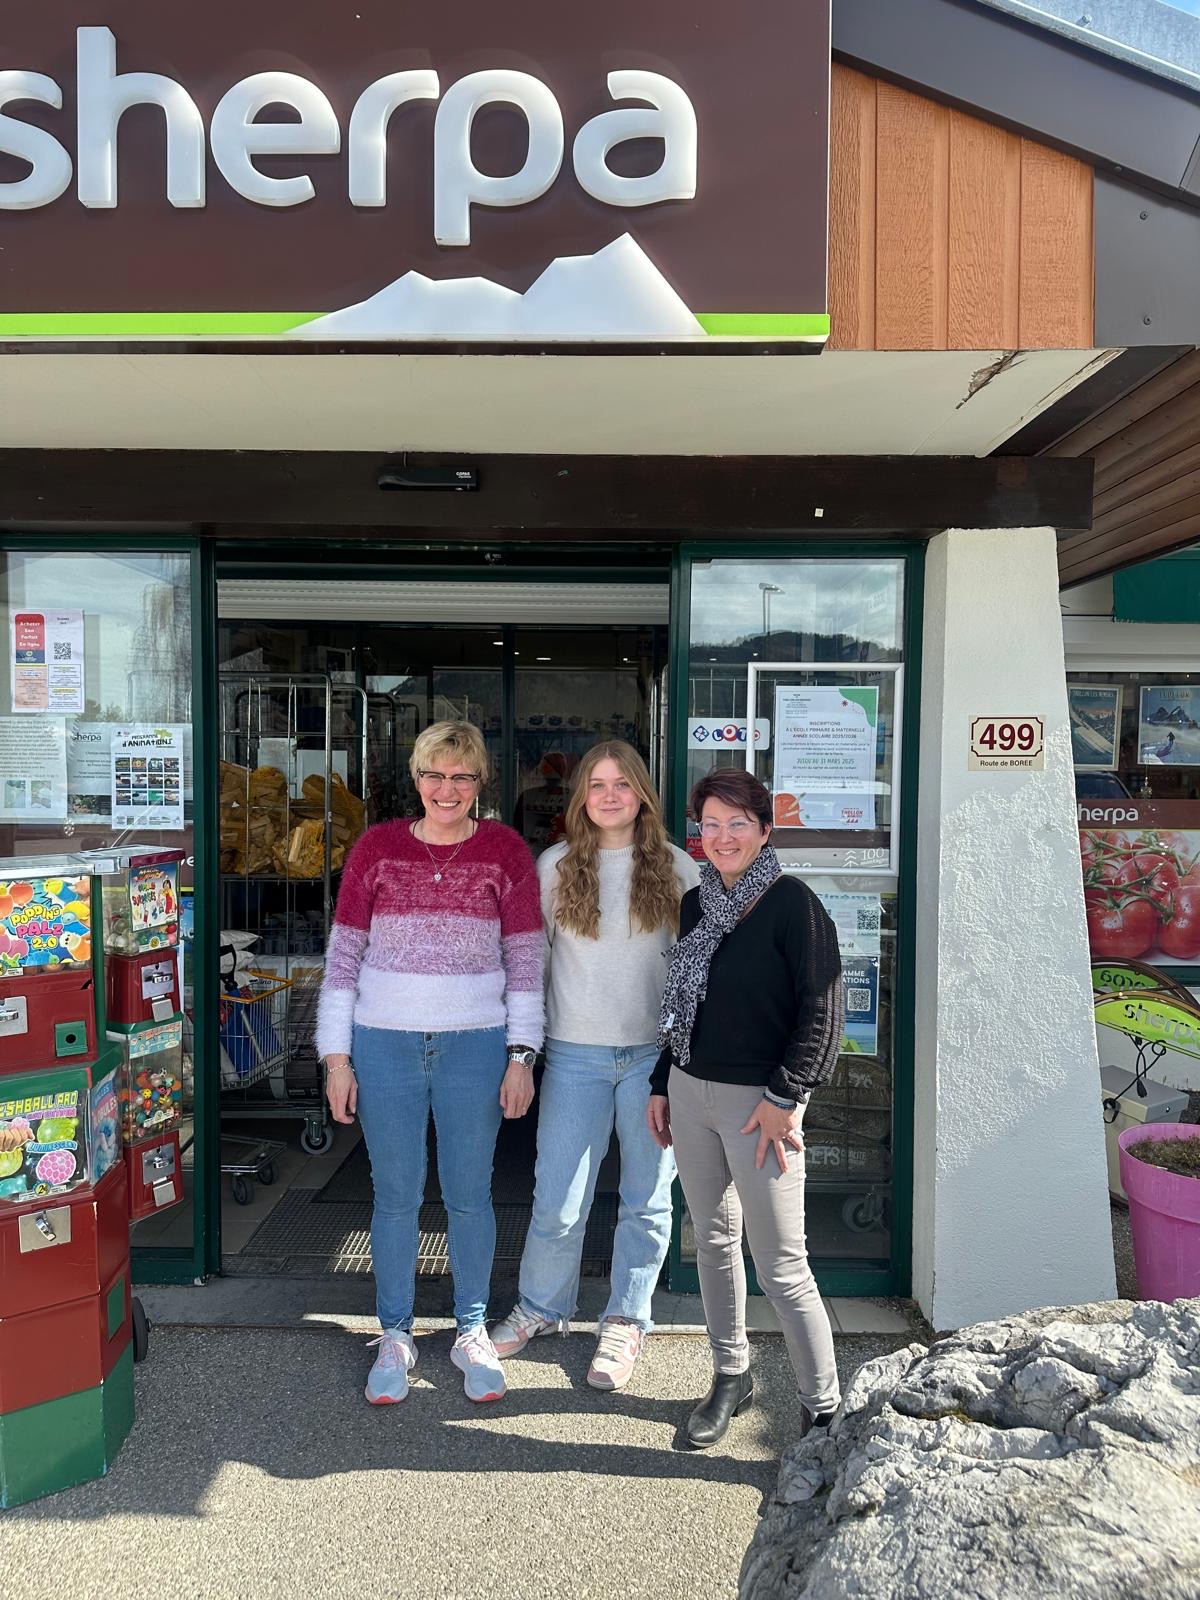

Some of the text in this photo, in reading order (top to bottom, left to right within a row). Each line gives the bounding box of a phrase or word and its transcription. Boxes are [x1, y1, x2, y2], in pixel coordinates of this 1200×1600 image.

[0, 26, 698, 247] sherpa
[71, 732, 102, 742] sherpa
[979, 723, 1035, 751] 499
[1078, 803, 1139, 825] herpa
[10, 904, 60, 926] POPPING
[15, 920, 64, 938] PALZ
[31, 936, 58, 949] 2.0
[57, 1091, 78, 1107] PRO
